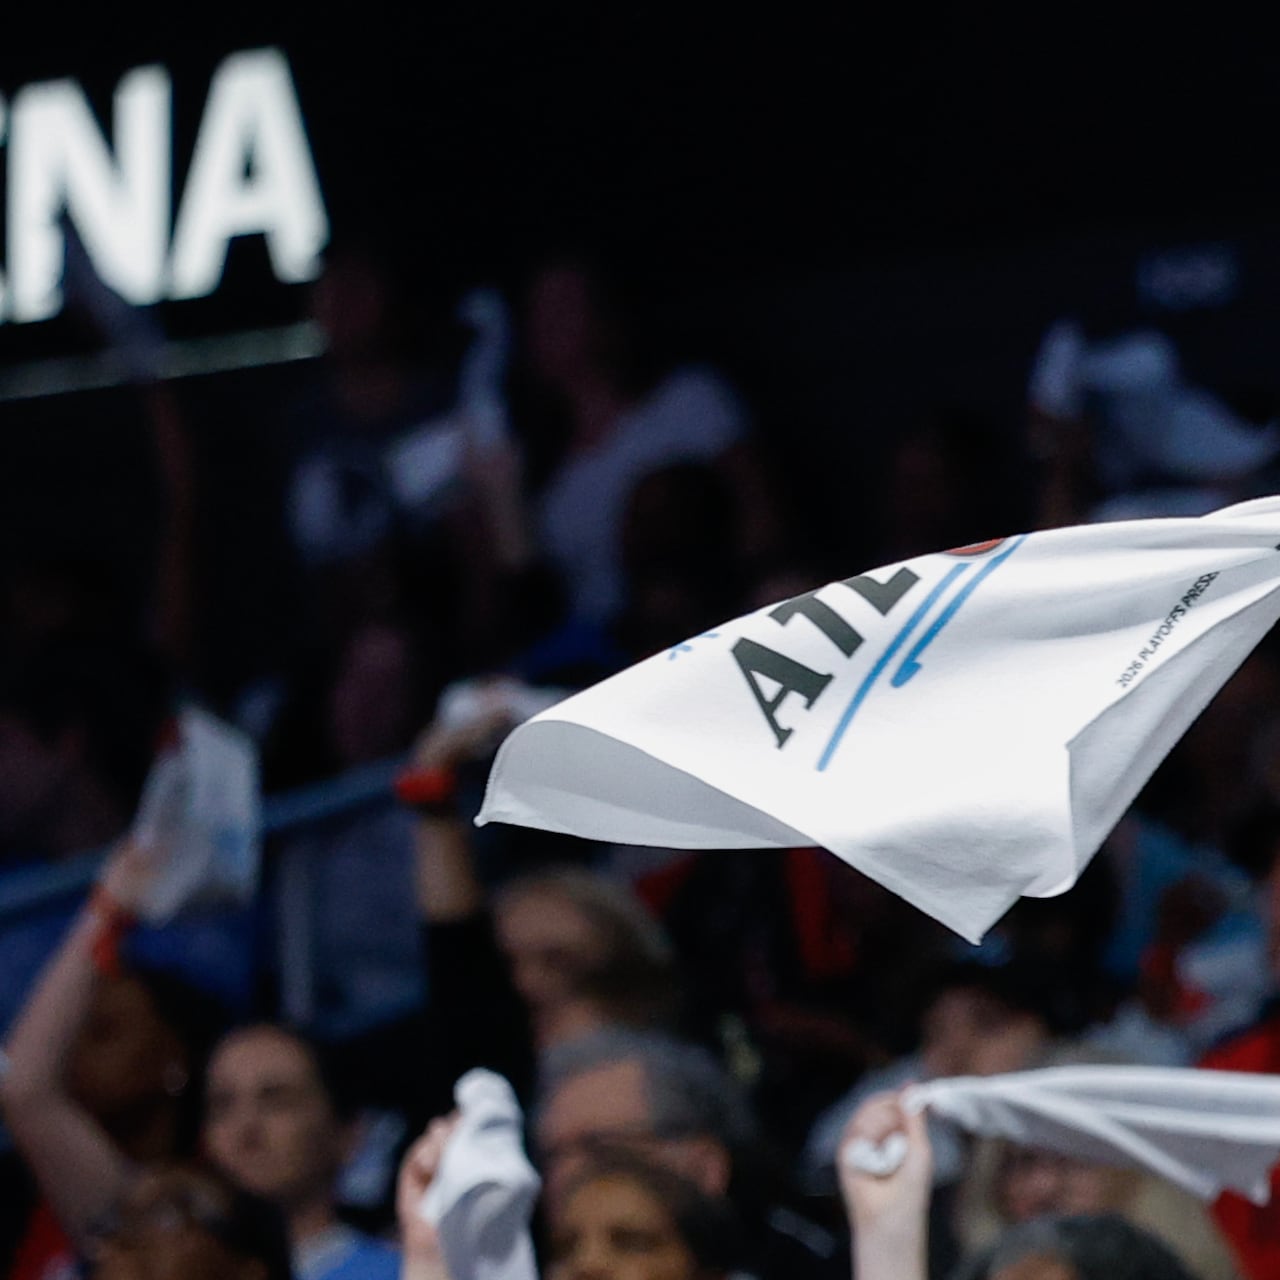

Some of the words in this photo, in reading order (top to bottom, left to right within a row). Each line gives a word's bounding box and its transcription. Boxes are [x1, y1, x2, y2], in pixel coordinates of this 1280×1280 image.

[0, 46, 331, 325] NA
[1116, 661, 1143, 688] 2026
[1140, 603, 1187, 661] PLAYOFFS
